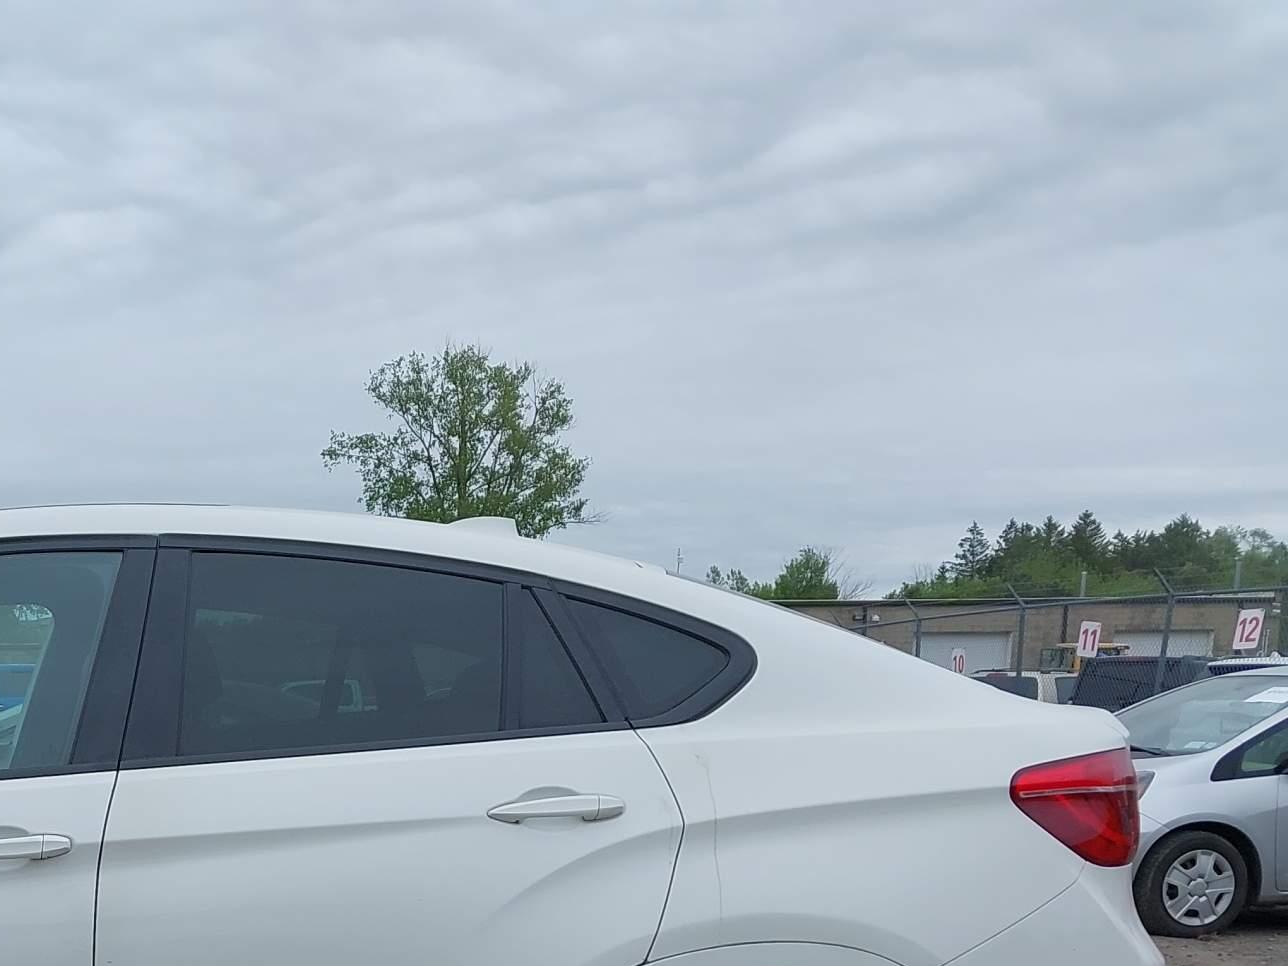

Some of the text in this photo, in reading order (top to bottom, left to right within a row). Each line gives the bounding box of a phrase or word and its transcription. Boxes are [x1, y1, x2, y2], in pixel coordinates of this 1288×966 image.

[1082, 628, 1098, 651] 11
[1239, 616, 1260, 643] 12
[952, 654, 965, 673] 10
